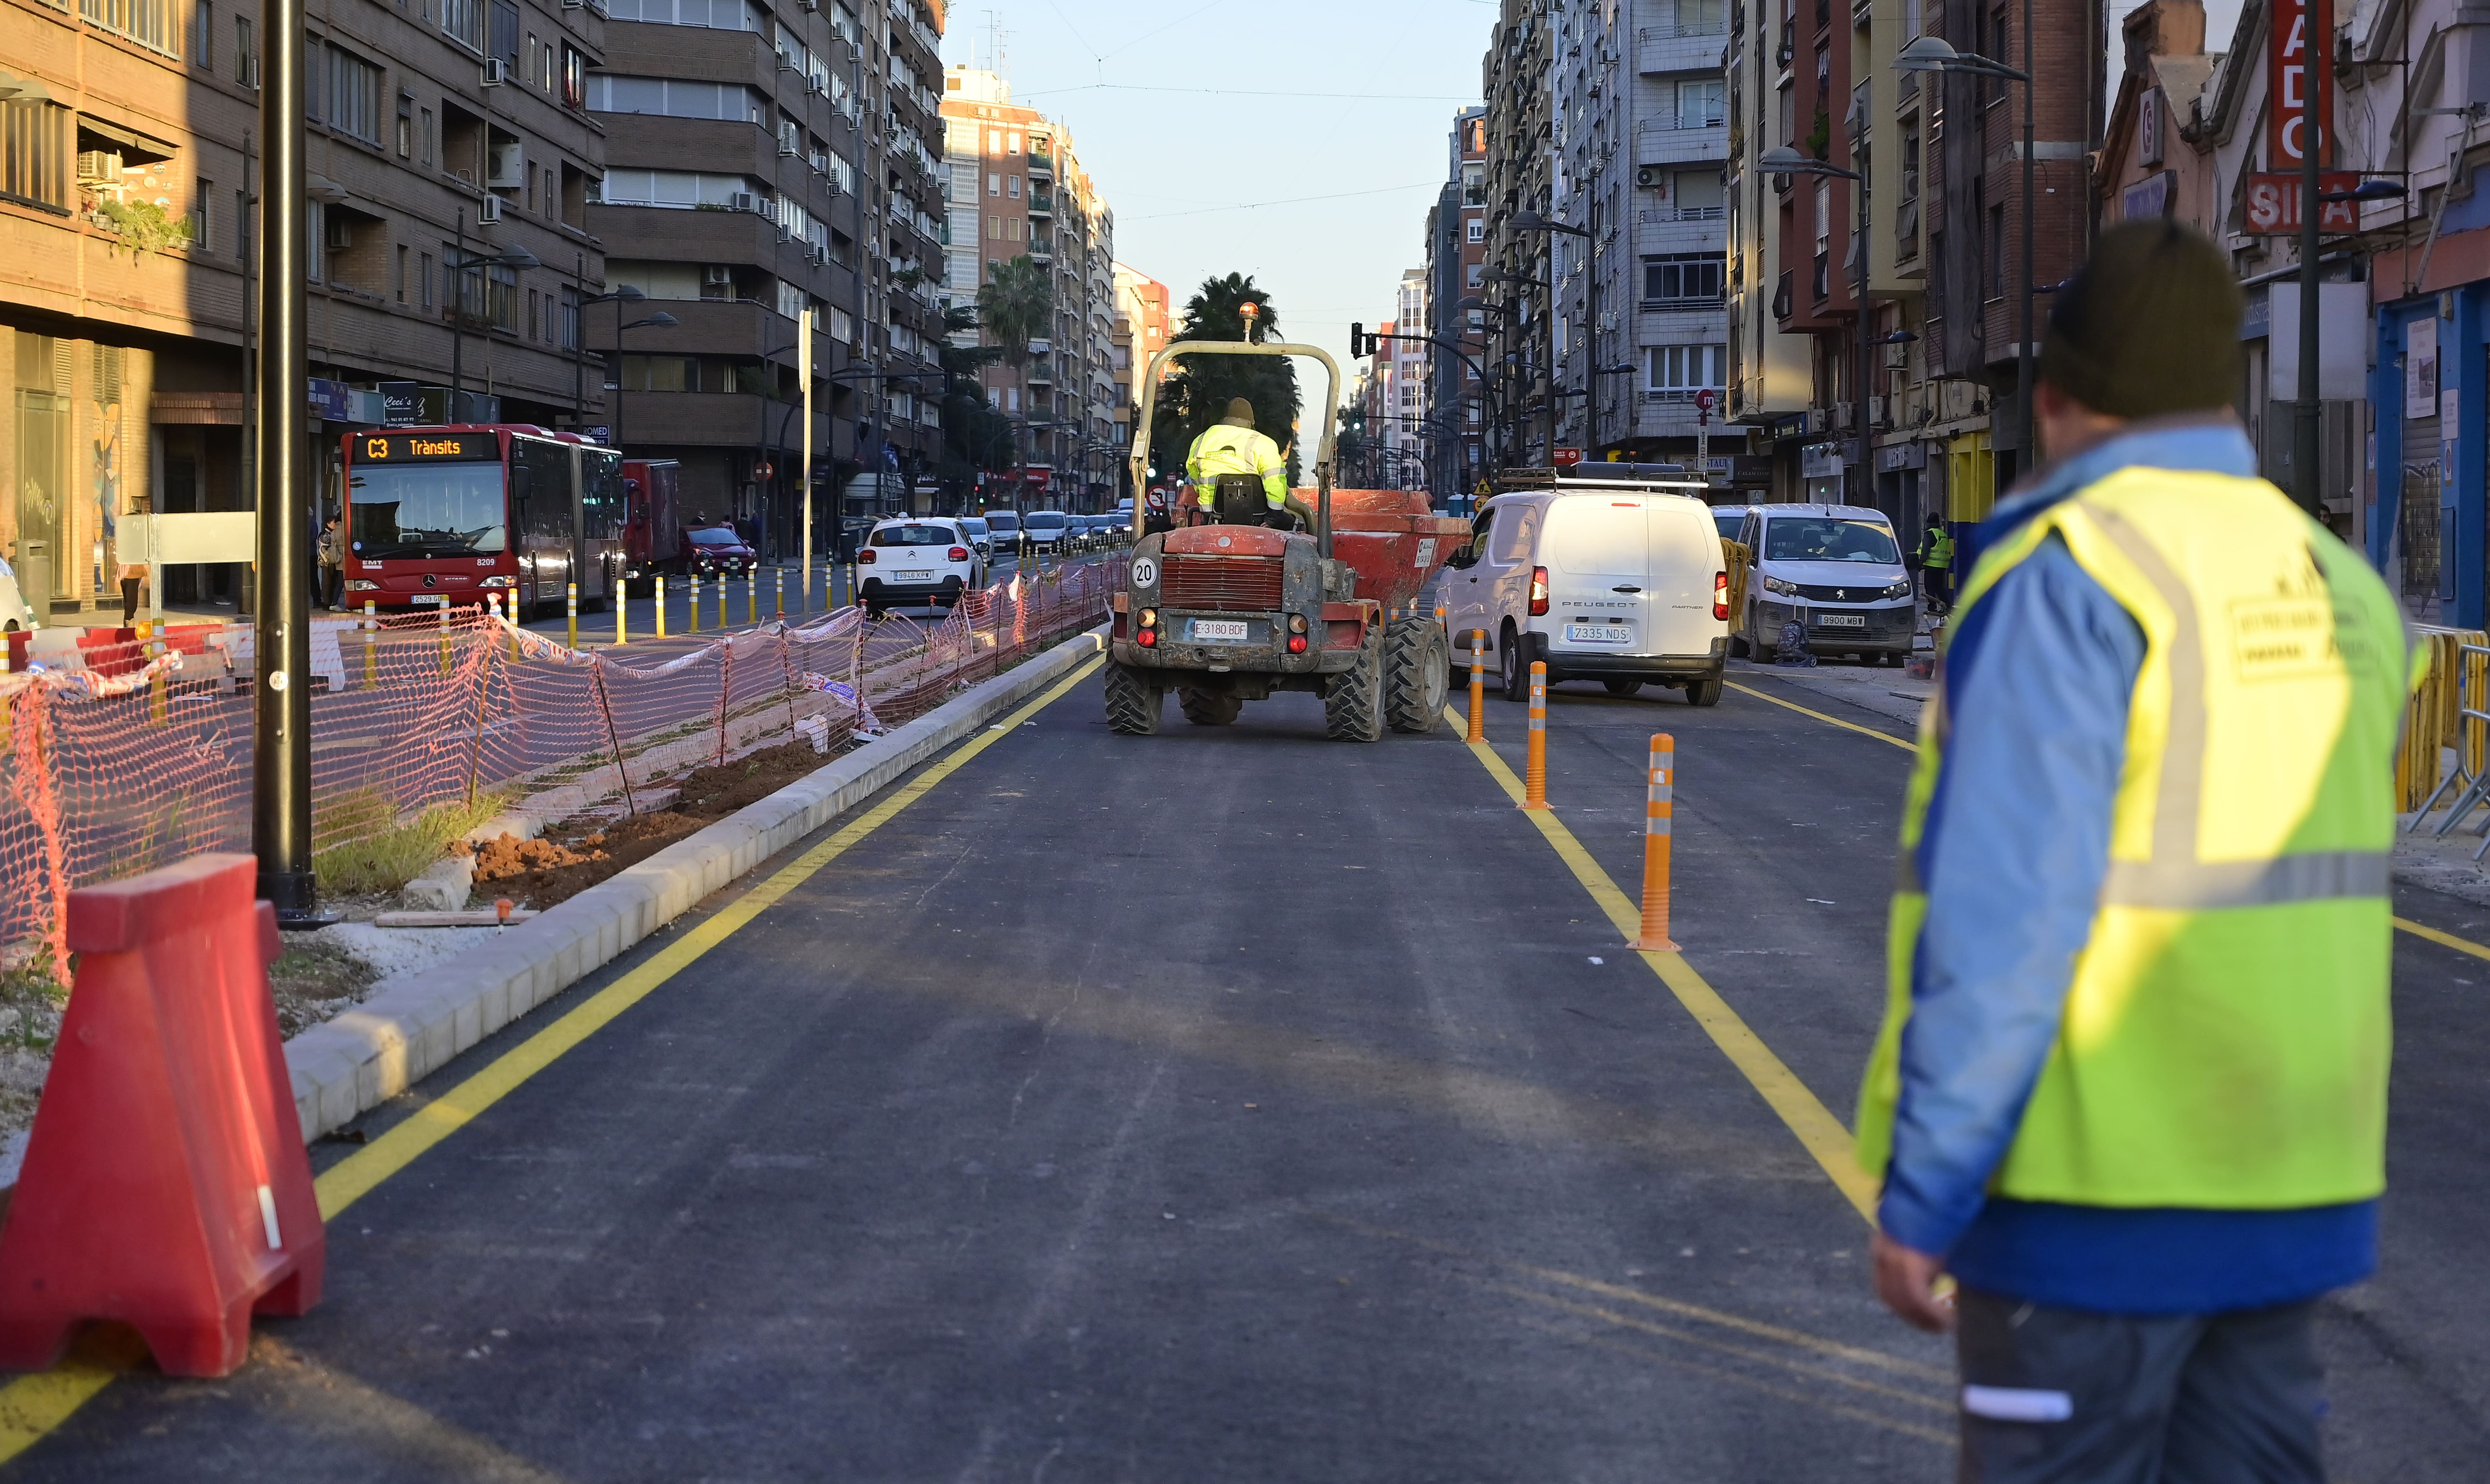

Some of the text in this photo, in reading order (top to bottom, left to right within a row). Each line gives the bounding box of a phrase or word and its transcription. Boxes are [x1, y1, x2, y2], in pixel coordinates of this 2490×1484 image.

[2282, 0, 2322, 158] ADO
[1704, 396, 1714, 405] m
[368, 439, 460, 458] C3 Trànsits
[1136, 564, 1151, 581] 20
[1229, 625, 1246, 635] BDF
[1575, 628, 1627, 640] 7335 NDS
